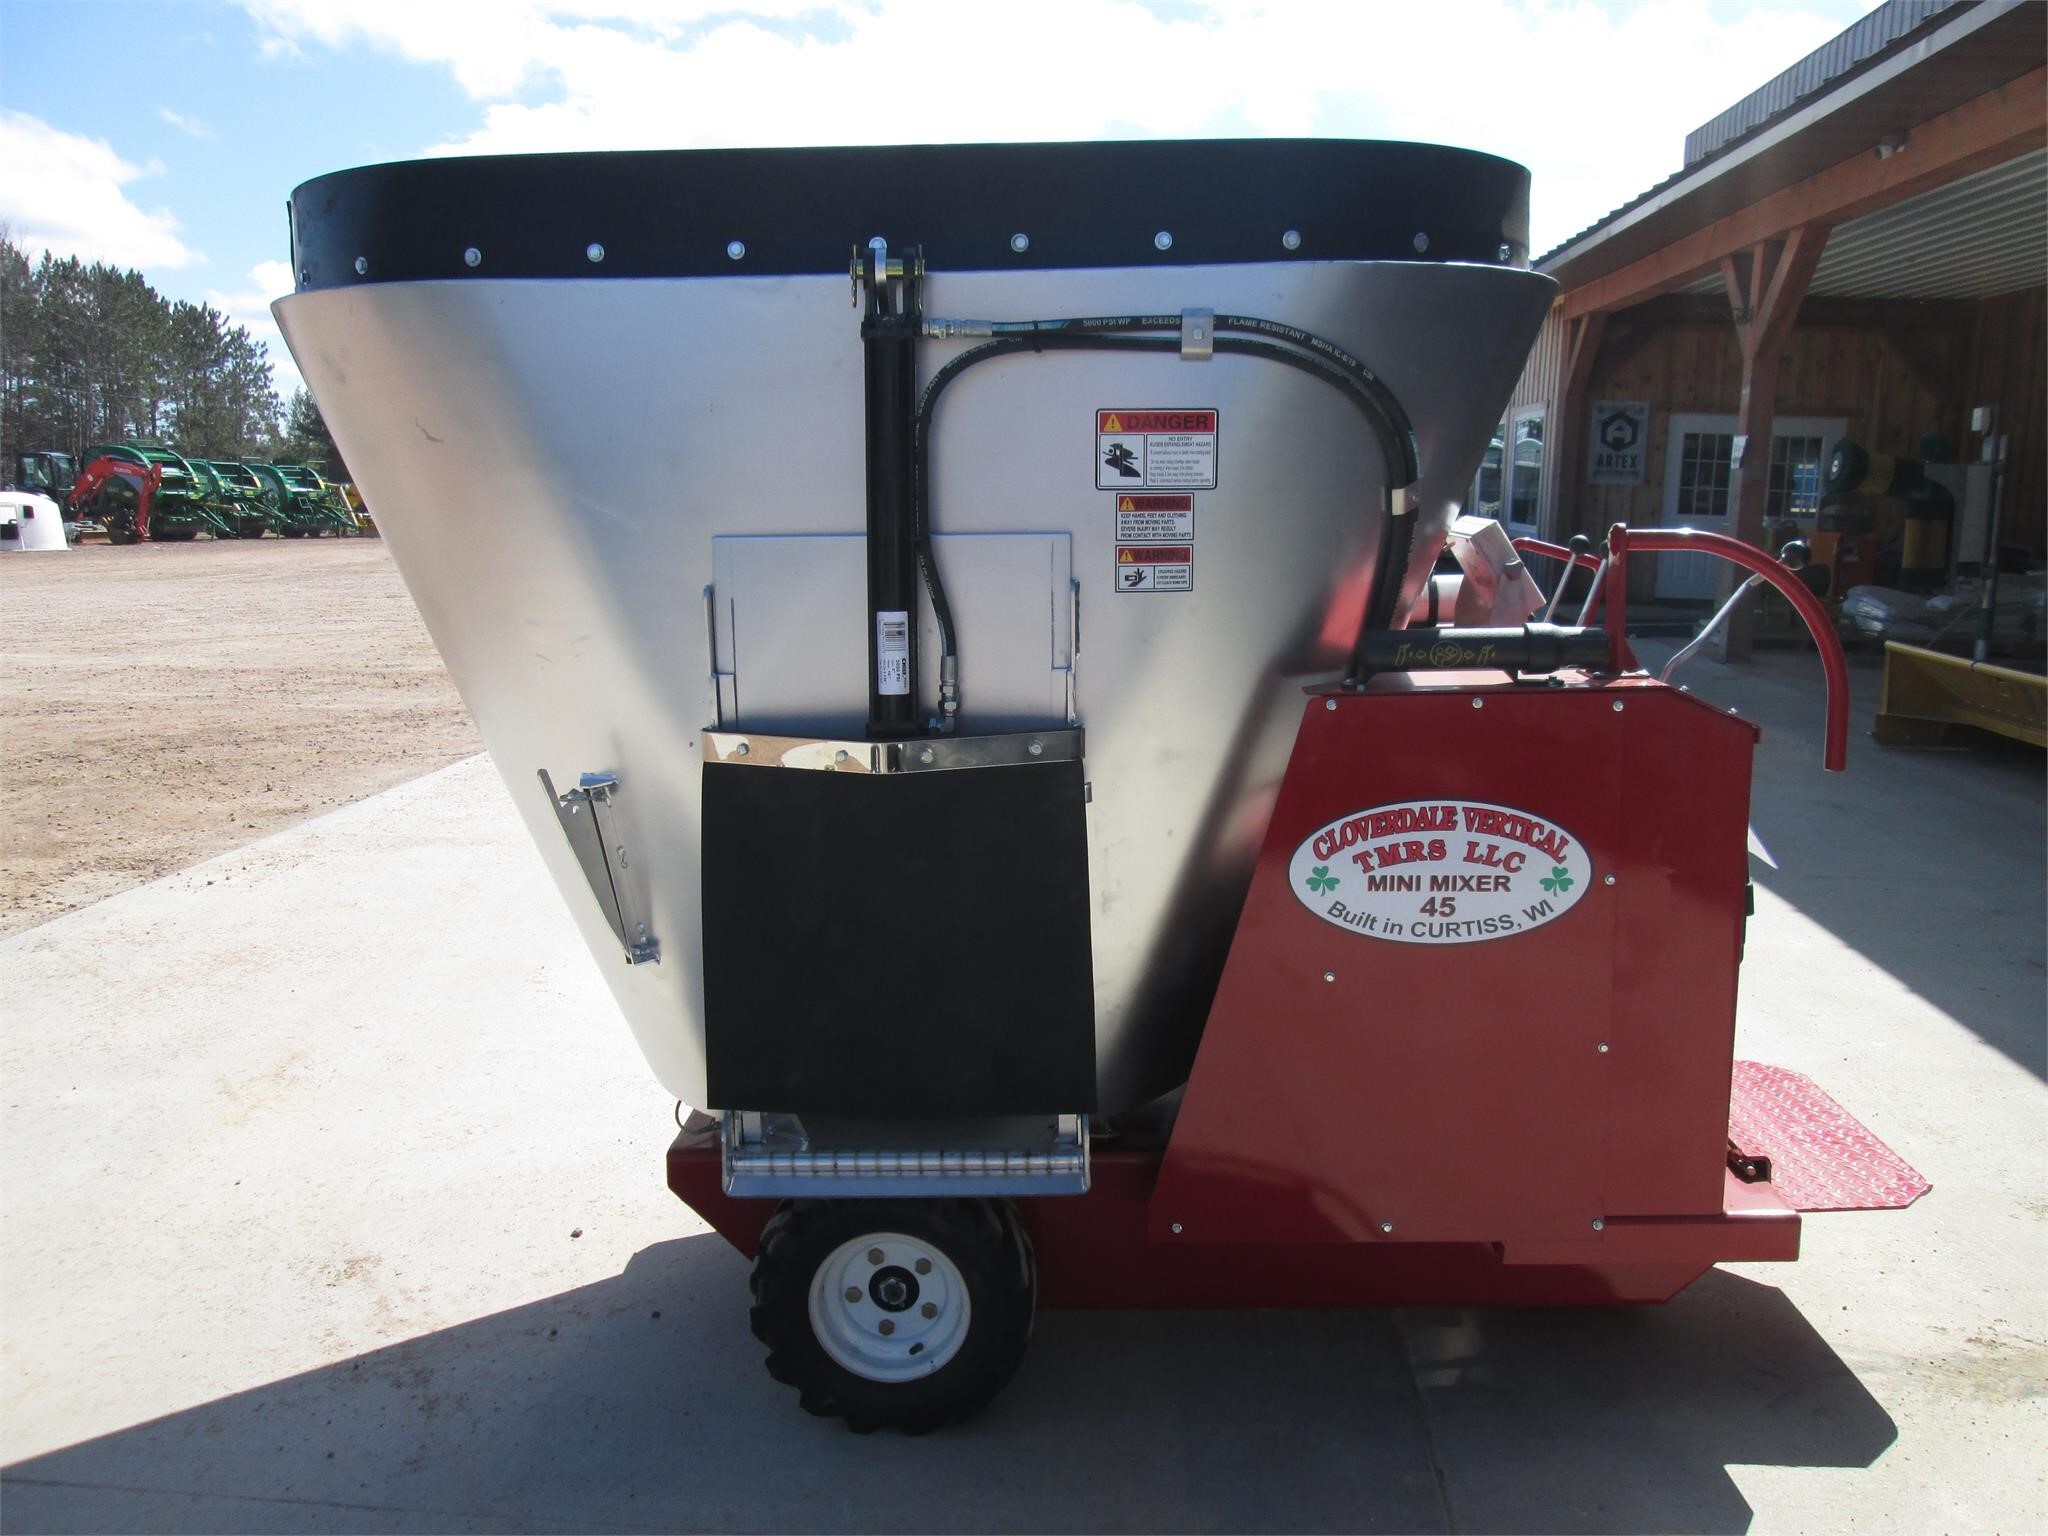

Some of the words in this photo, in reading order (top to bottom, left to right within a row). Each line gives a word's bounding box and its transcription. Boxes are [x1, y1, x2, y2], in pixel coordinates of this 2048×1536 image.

[1141, 316, 1181, 325] EXCEEDS
[1228, 317, 1258, 328] FLAME
[1260, 321, 1305, 340] RESISTANT
[1127, 415, 1208, 430] DANGER
[1597, 454, 1638, 469] ARTEX
[1136, 549, 1187, 562] WARNING
[1312, 806, 1458, 861] CLOVERDALE
[1462, 807, 1570, 864] VERTICAL
[1352, 840, 1446, 874] TMRS
[1463, 841, 1526, 873] LLC
[1368, 876, 1425, 892] MINI
[1430, 876, 1512, 892] MIXER
[1420, 896, 1456, 918] 45
[1326, 900, 1378, 931] Built
[1383, 918, 1403, 936] in
[1410, 914, 1522, 938] CURTISS,
[1522, 899, 1554, 922] WI
